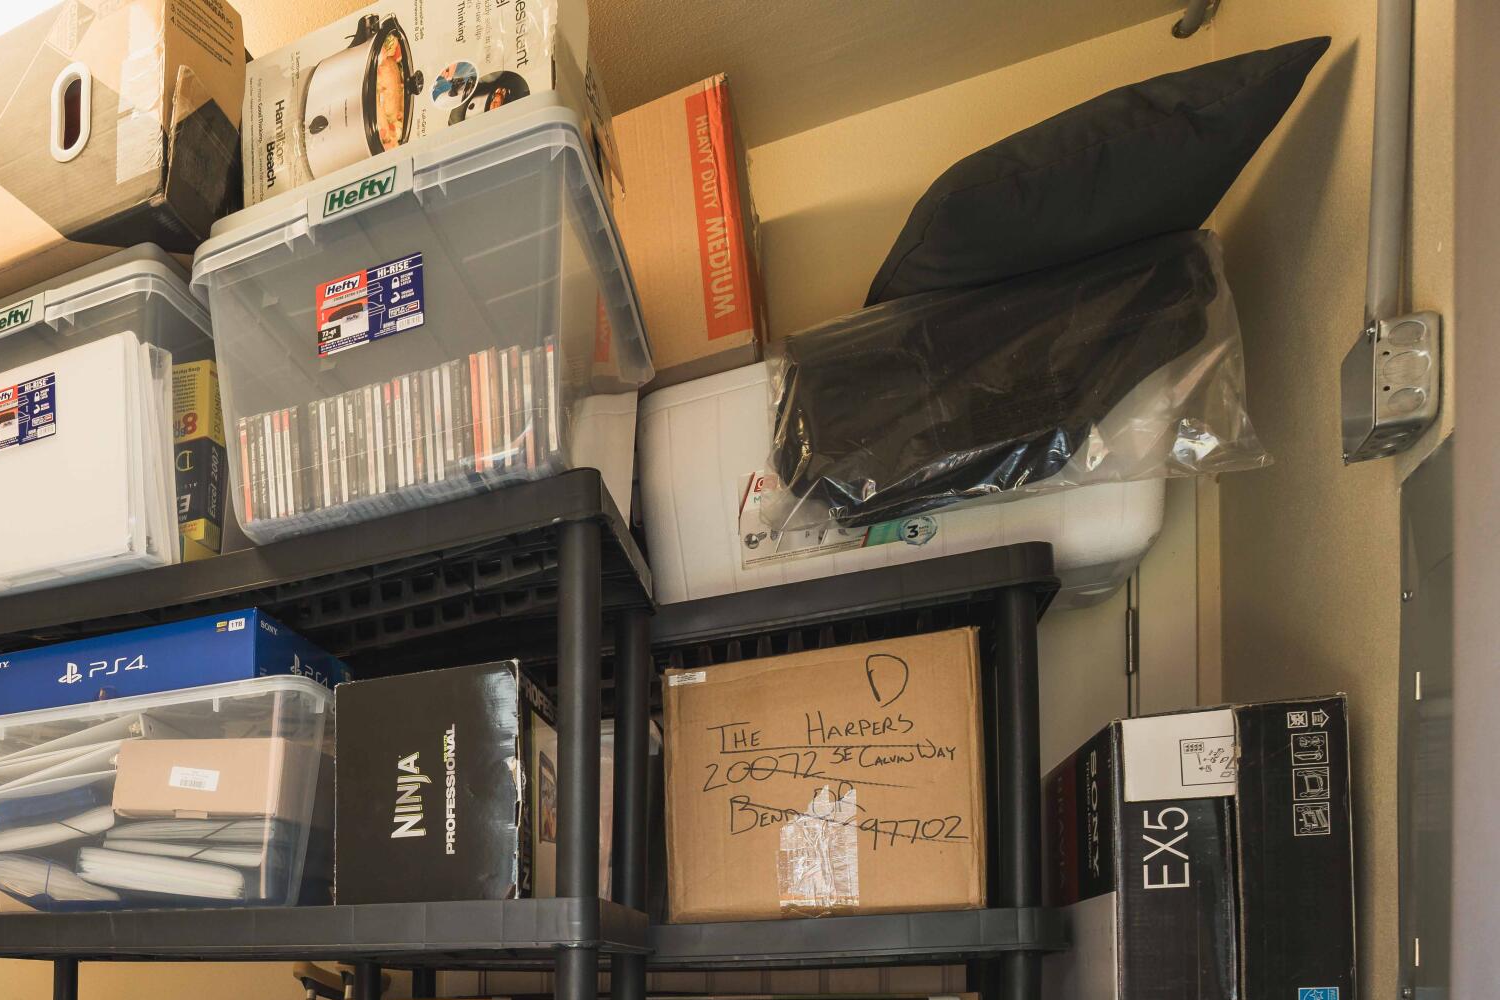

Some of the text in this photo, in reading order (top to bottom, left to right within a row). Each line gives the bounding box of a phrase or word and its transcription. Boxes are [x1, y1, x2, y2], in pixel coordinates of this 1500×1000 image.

[515, 0, 529, 68] esistant
[275, 99, 286, 165] Hamilton
[266, 141, 277, 189] Beach
[328, 175, 391, 212] Hefty
[695, 114, 736, 319] HEAVY DUTY MEDIUM
[326, 279, 358, 296] Hefty
[377, 260, 409, 278] HI-RISE
[182, 412, 198, 434] 8
[208, 446, 220, 519] Excel 2007
[907, 525, 919, 538] 3
[260, 620, 278, 635] SONY
[89, 654, 147, 678] PS4
[866, 653, 909, 708] D
[707, 710, 914, 752] THE HARPERS
[446, 723, 455, 854] PROFESSIONAL
[703, 751, 825, 792] 20072
[829, 746, 852, 765] SE
[916, 738, 957, 761] WAY
[391, 751, 431, 838] NINJA
[1090, 750, 1100, 877] SONY
[859, 816, 969, 850] 97702
[1142, 806, 1190, 889] EX5
